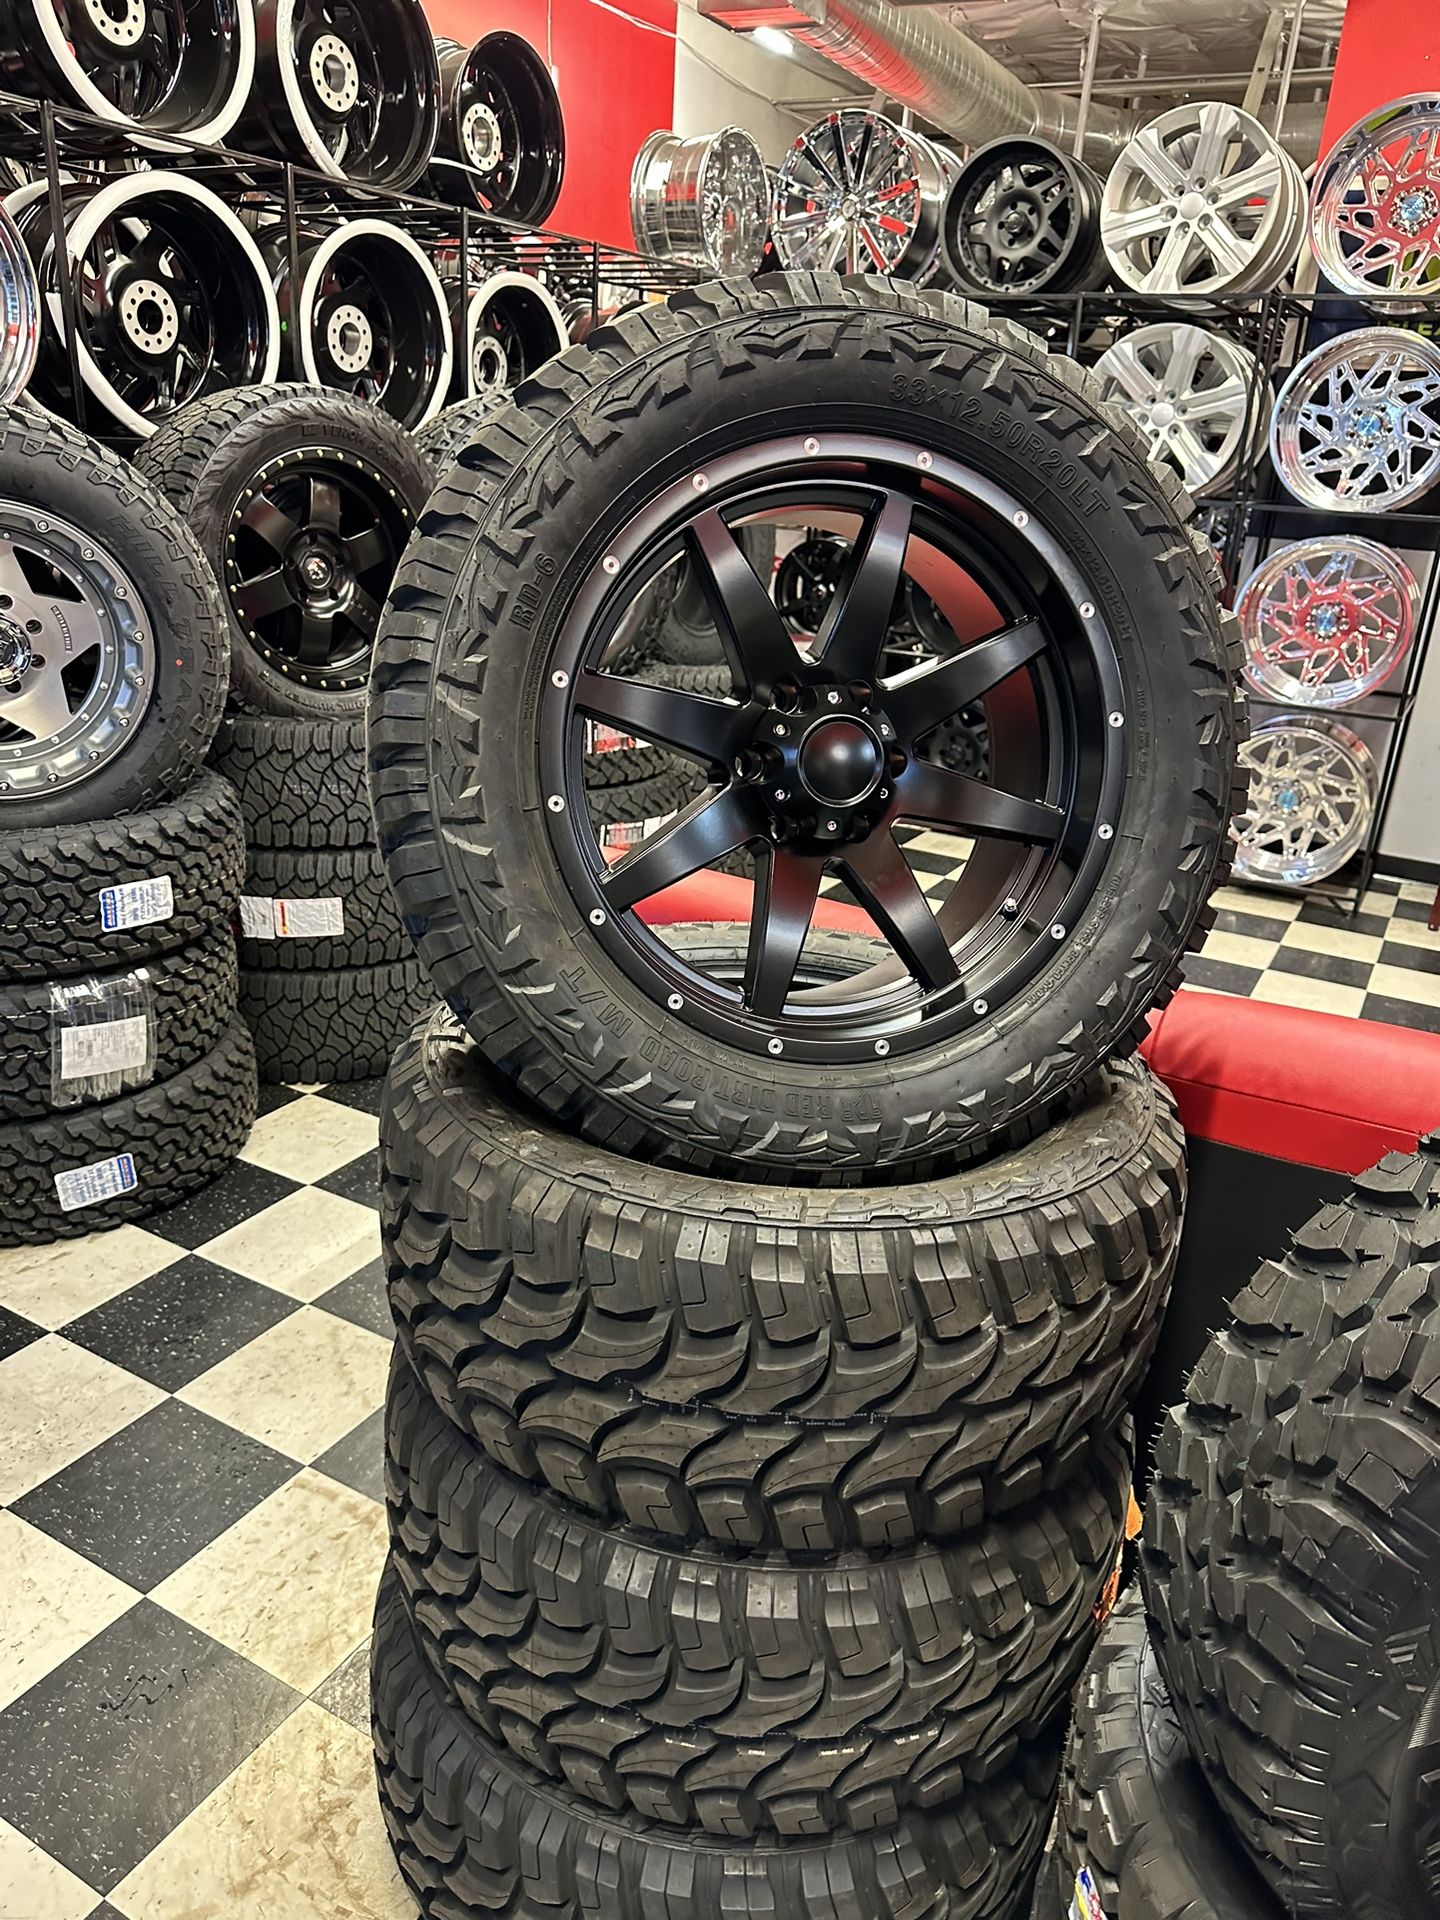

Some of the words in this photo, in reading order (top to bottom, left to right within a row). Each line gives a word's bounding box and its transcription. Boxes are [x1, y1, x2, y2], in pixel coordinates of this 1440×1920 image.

[107, 515, 180, 604] HILL
[508, 552, 557, 631] RD-6
[558, 965, 634, 1039] M/T
[639, 1036, 712, 1092] ROAD
[712, 1074, 778, 1114] DIRT
[782, 1093, 832, 1119] RED
